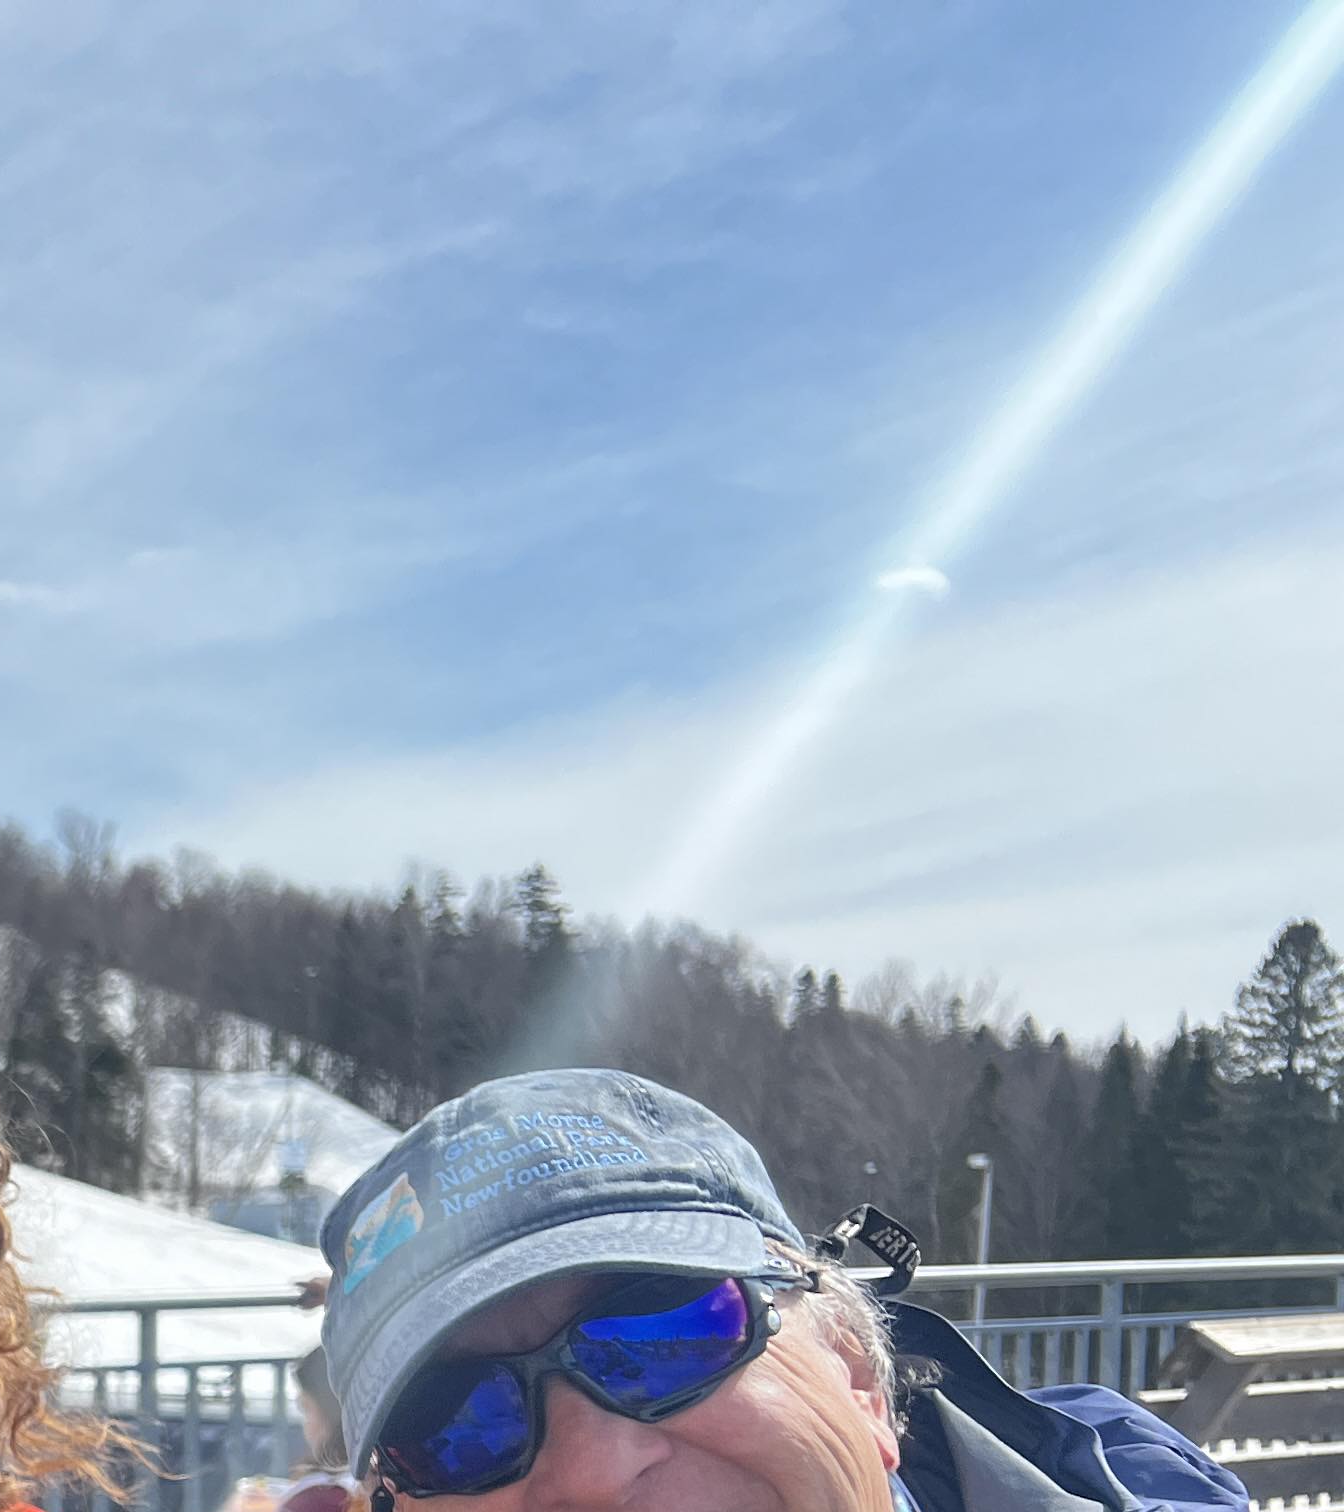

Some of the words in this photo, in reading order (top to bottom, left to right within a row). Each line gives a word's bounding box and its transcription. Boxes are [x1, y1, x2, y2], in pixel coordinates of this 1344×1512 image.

[516, 1111, 606, 1131] Morne
[436, 1131, 559, 1191] National
[566, 1129, 633, 1149] Park
[440, 1147, 648, 1217] Newfoundland
